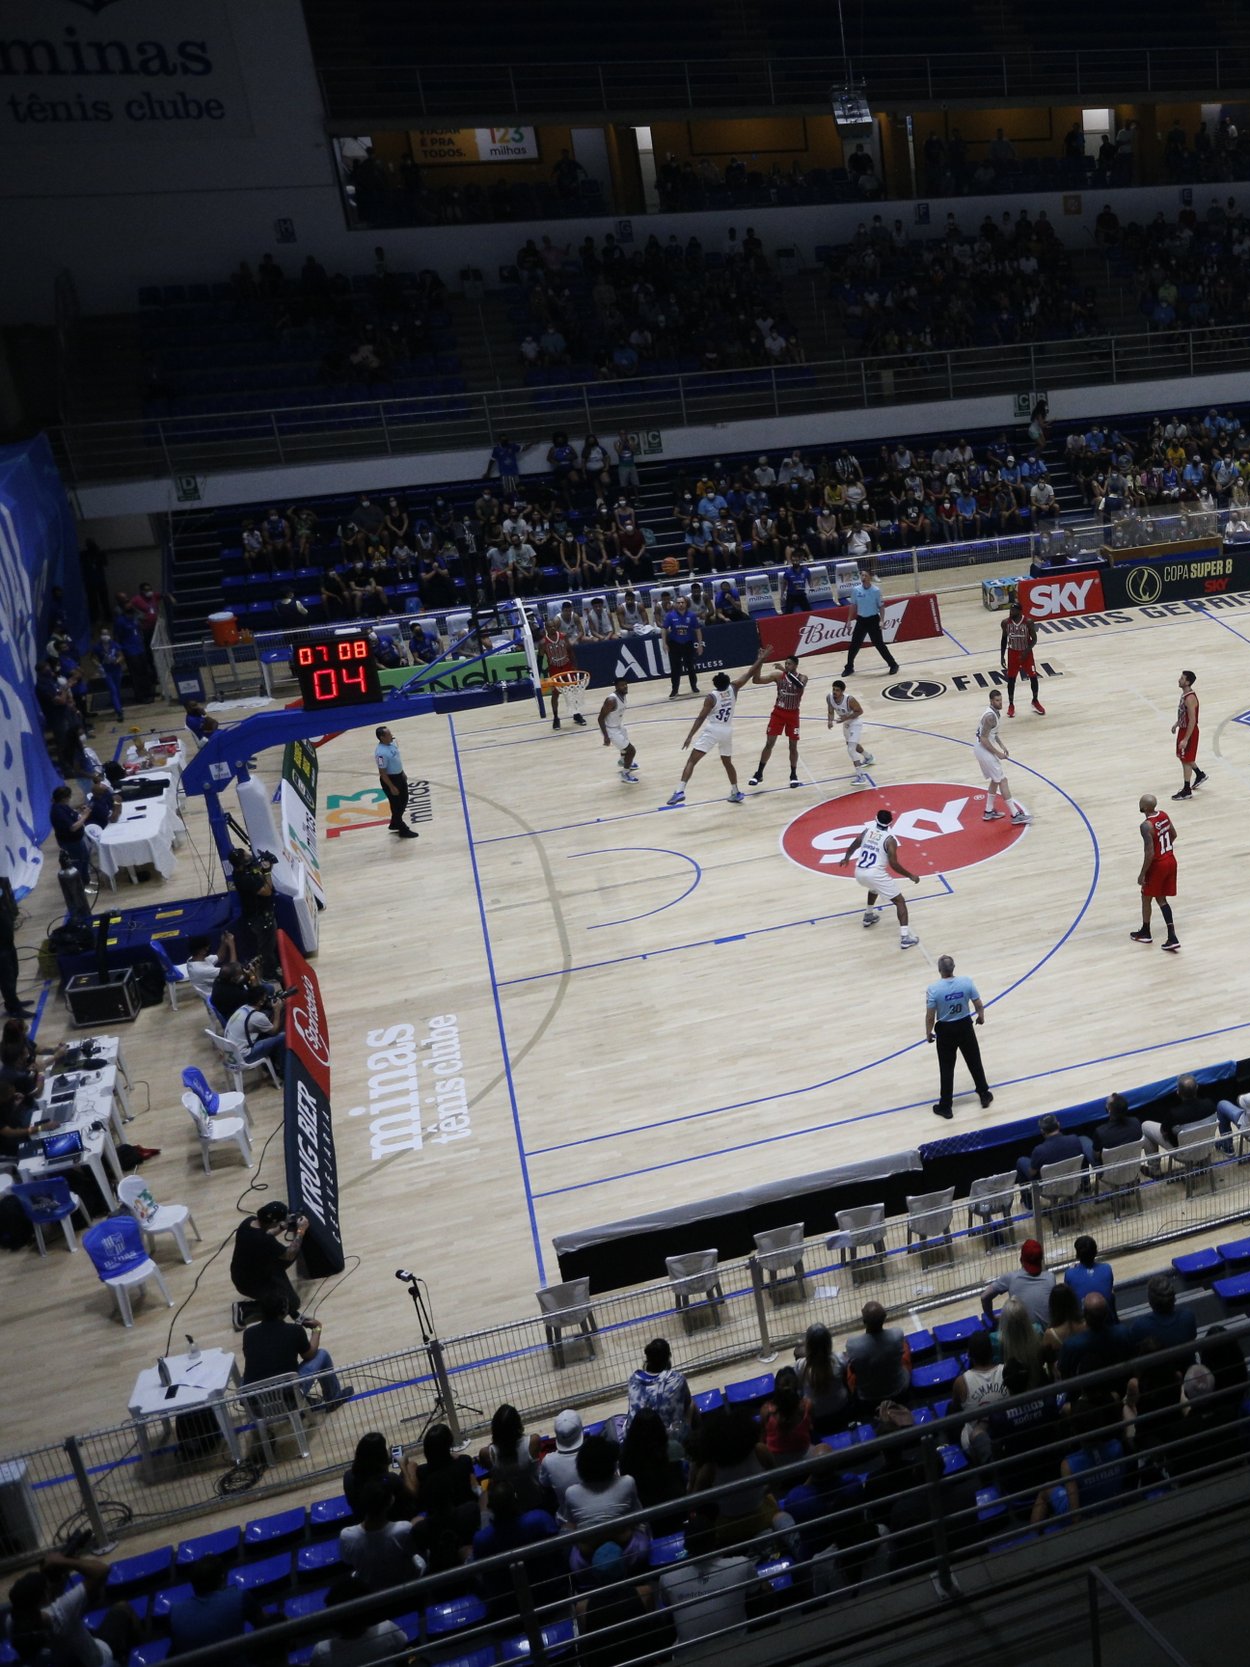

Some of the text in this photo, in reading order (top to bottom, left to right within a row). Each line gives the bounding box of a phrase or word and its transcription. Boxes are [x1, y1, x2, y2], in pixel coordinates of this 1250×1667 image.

[0, 26, 213, 76] minas
[8, 92, 226, 123] tênis clube
[489, 127, 525, 144] 123
[422, 149, 467, 158] TODOS.
[490, 146, 527, 156] milhas
[1164, 559, 1233, 582] COPA SUPER 8
[1204, 578, 1229, 593] SKY
[1029, 579, 1084, 618] SKY
[299, 640, 367, 666] 07 08
[314, 665, 368, 701] 04
[326, 788, 392, 839] 123
[1159, 831, 1173, 856] 11
[857, 850, 878, 869] 22
[949, 1003, 962, 1015] 30
[347, 1023, 424, 1160] minas
[421, 1013, 473, 1145] tênis clube
[296, 1079, 326, 1226] KRUG BIER
[320, 1109, 342, 1244] CERVEJARIA
[971, 1382, 1009, 1403] SIMMONS
[1006, 1399, 1045, 1419] minas
